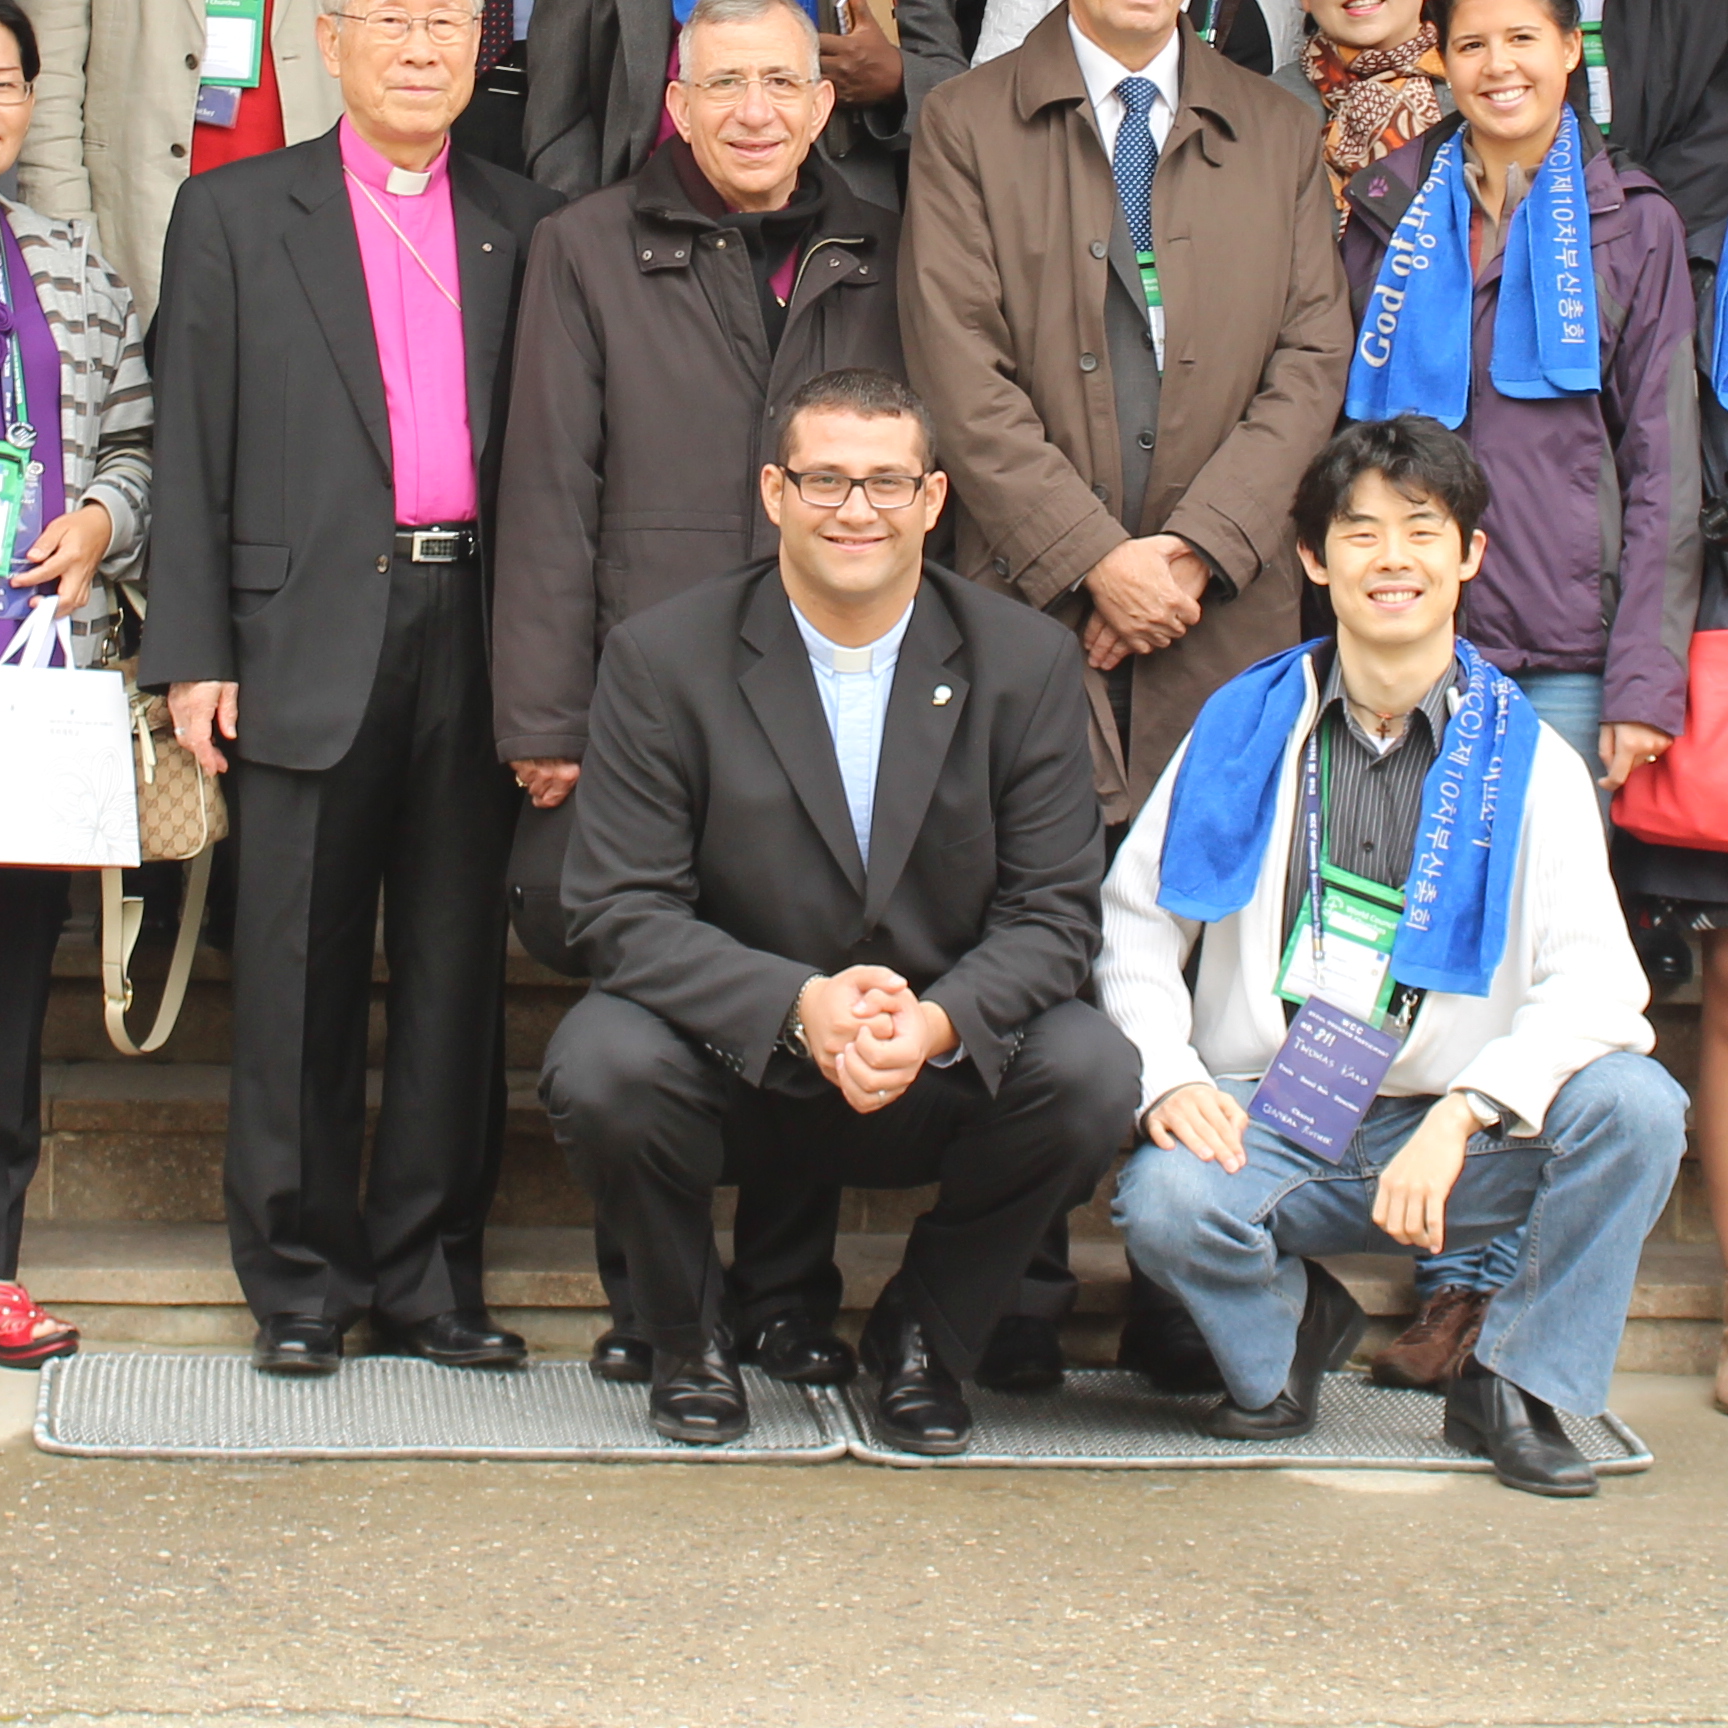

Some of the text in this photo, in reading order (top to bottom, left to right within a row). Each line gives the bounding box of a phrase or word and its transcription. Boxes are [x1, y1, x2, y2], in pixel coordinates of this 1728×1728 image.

[1359, 284, 1406, 368] God
[1389, 231, 1416, 277] of
[1341, 1018, 1365, 1036] WCC
